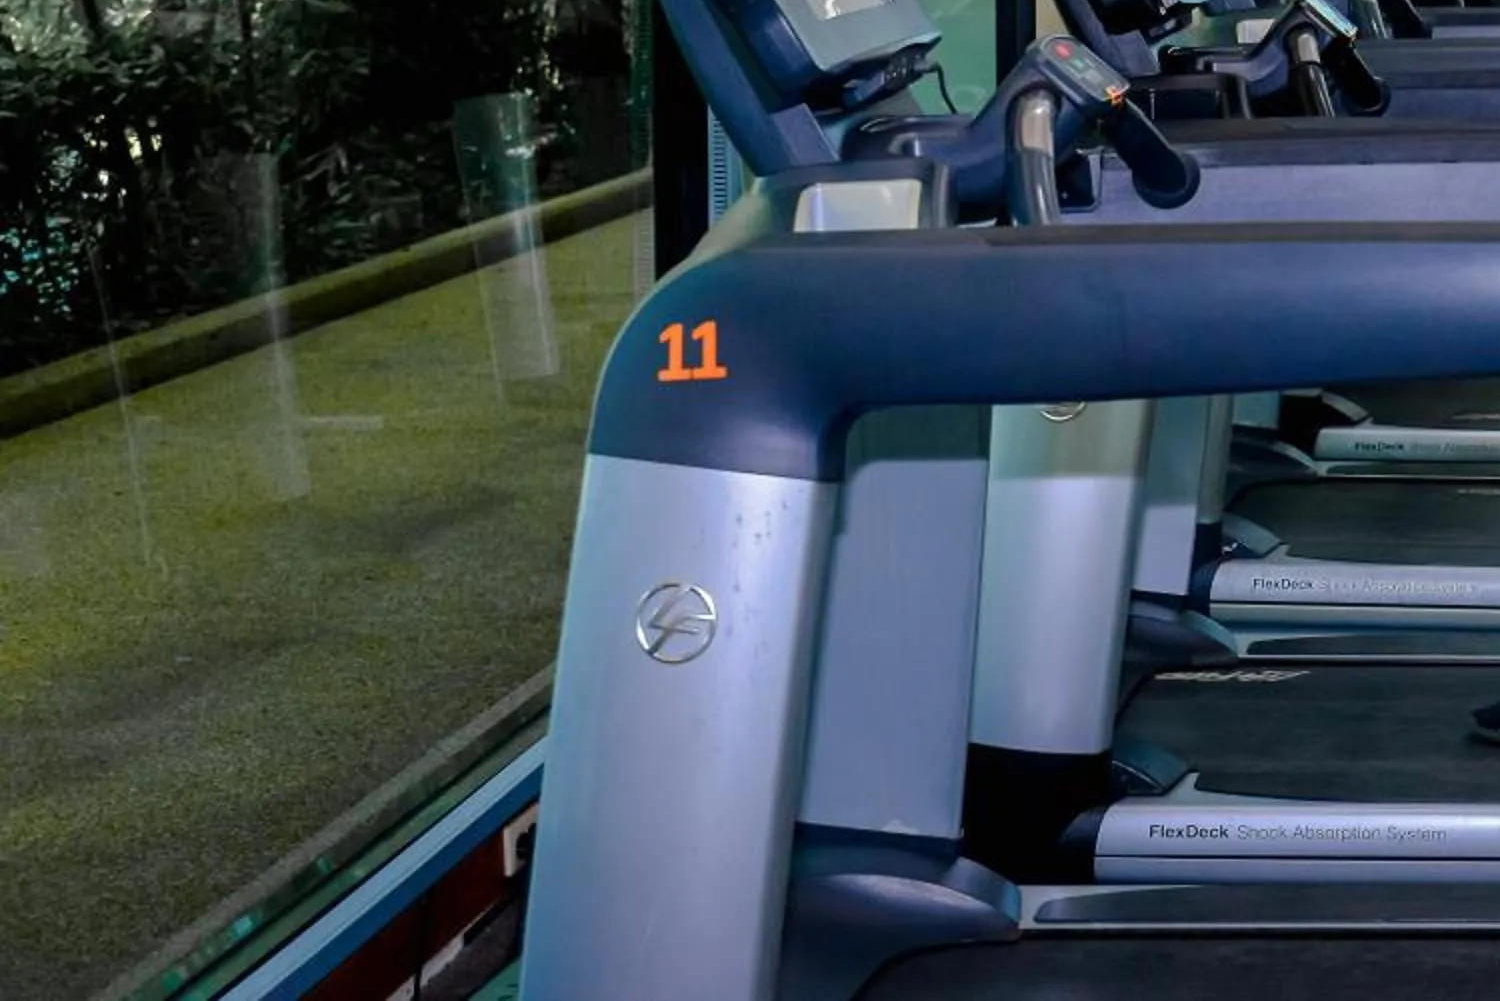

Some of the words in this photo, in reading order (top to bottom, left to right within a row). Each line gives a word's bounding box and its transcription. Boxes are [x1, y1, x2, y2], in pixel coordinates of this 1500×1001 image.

[658, 320, 727, 382] 11
[1149, 824, 1229, 840] FlexDeck
[1237, 825, 1286, 840] Shock
[1293, 826, 1381, 842] Absorption
[1387, 826, 1447, 843] System
